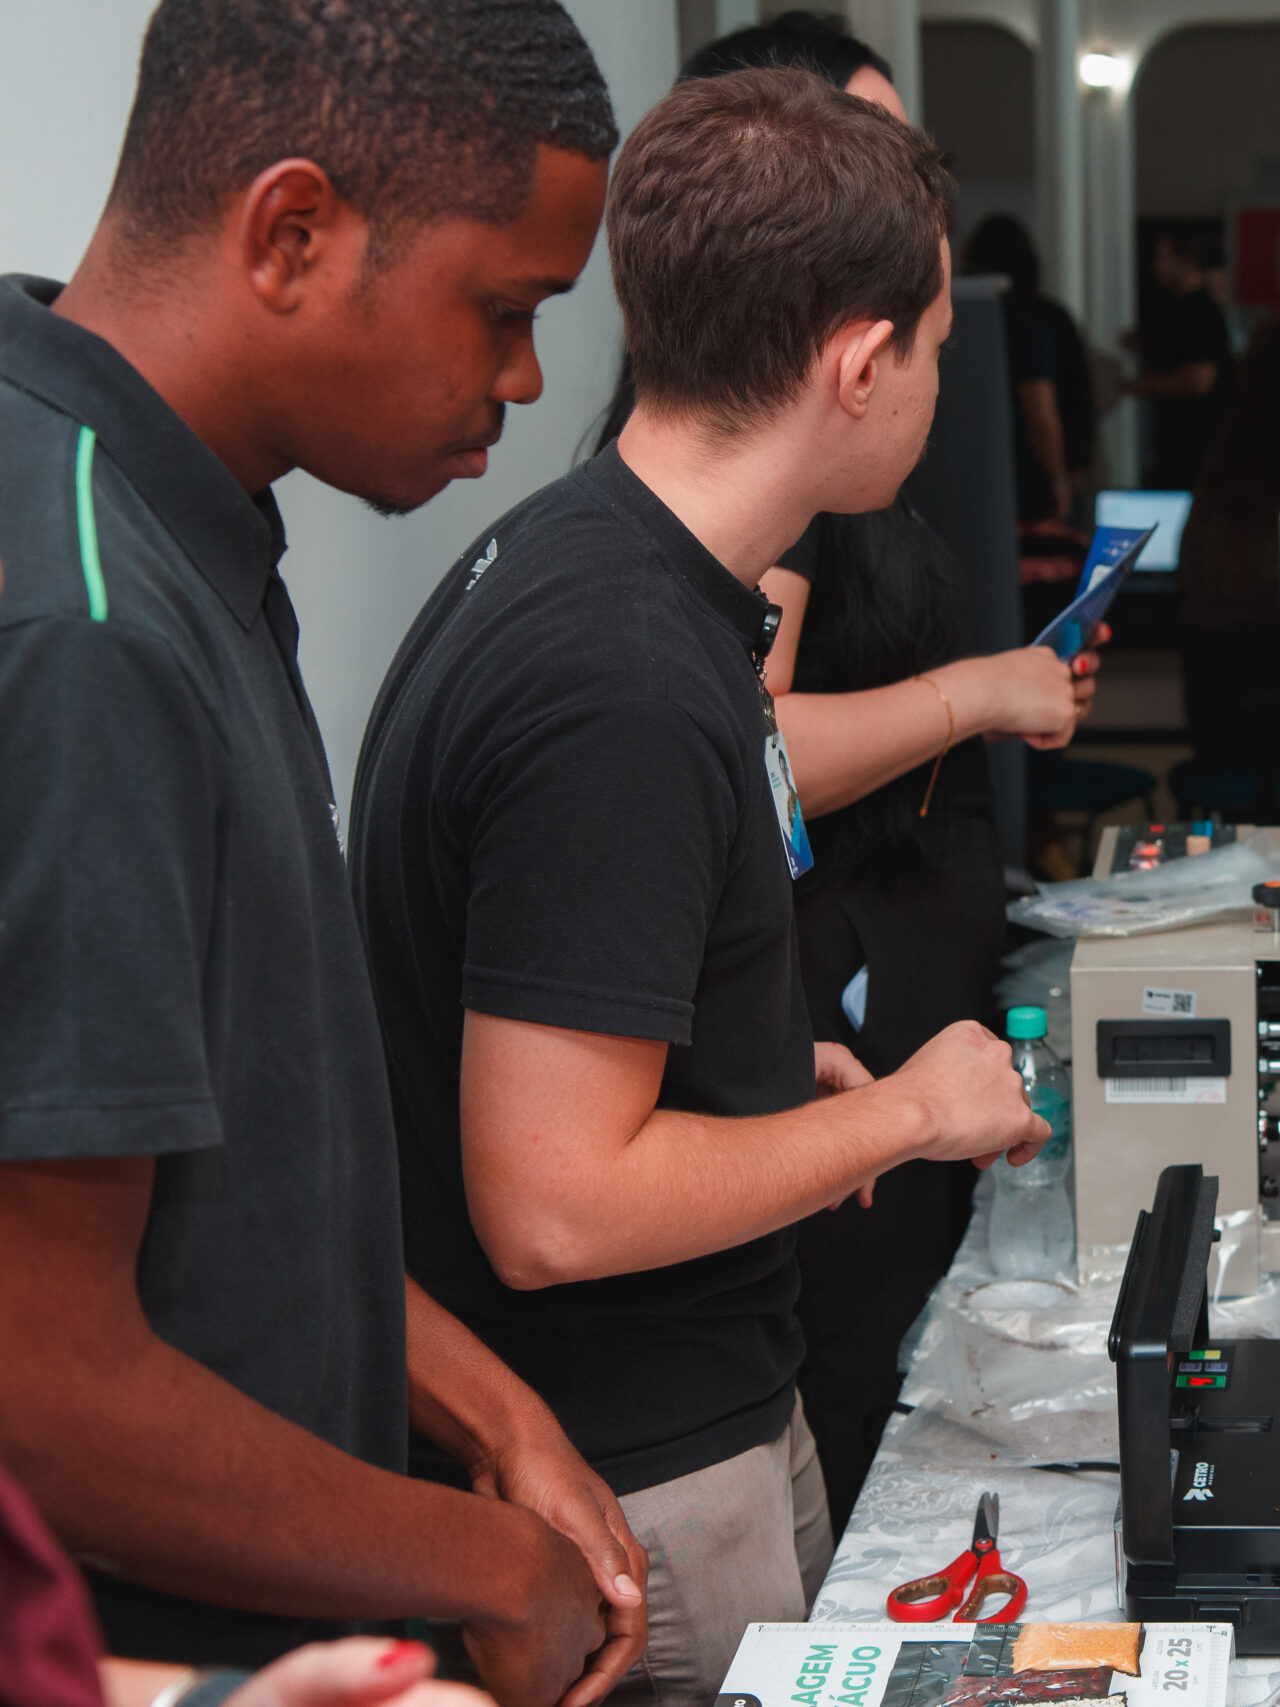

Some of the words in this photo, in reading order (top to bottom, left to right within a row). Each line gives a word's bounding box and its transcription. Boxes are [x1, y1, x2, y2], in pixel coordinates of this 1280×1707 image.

[1193, 1462, 1209, 1488] CETRO
[1167, 1638, 1193, 1657] 25
[791, 1645, 839, 1707] AGEM
[831, 1646, 883, 1707] ÁCUO
[1163, 1669, 1189, 1691] 20
